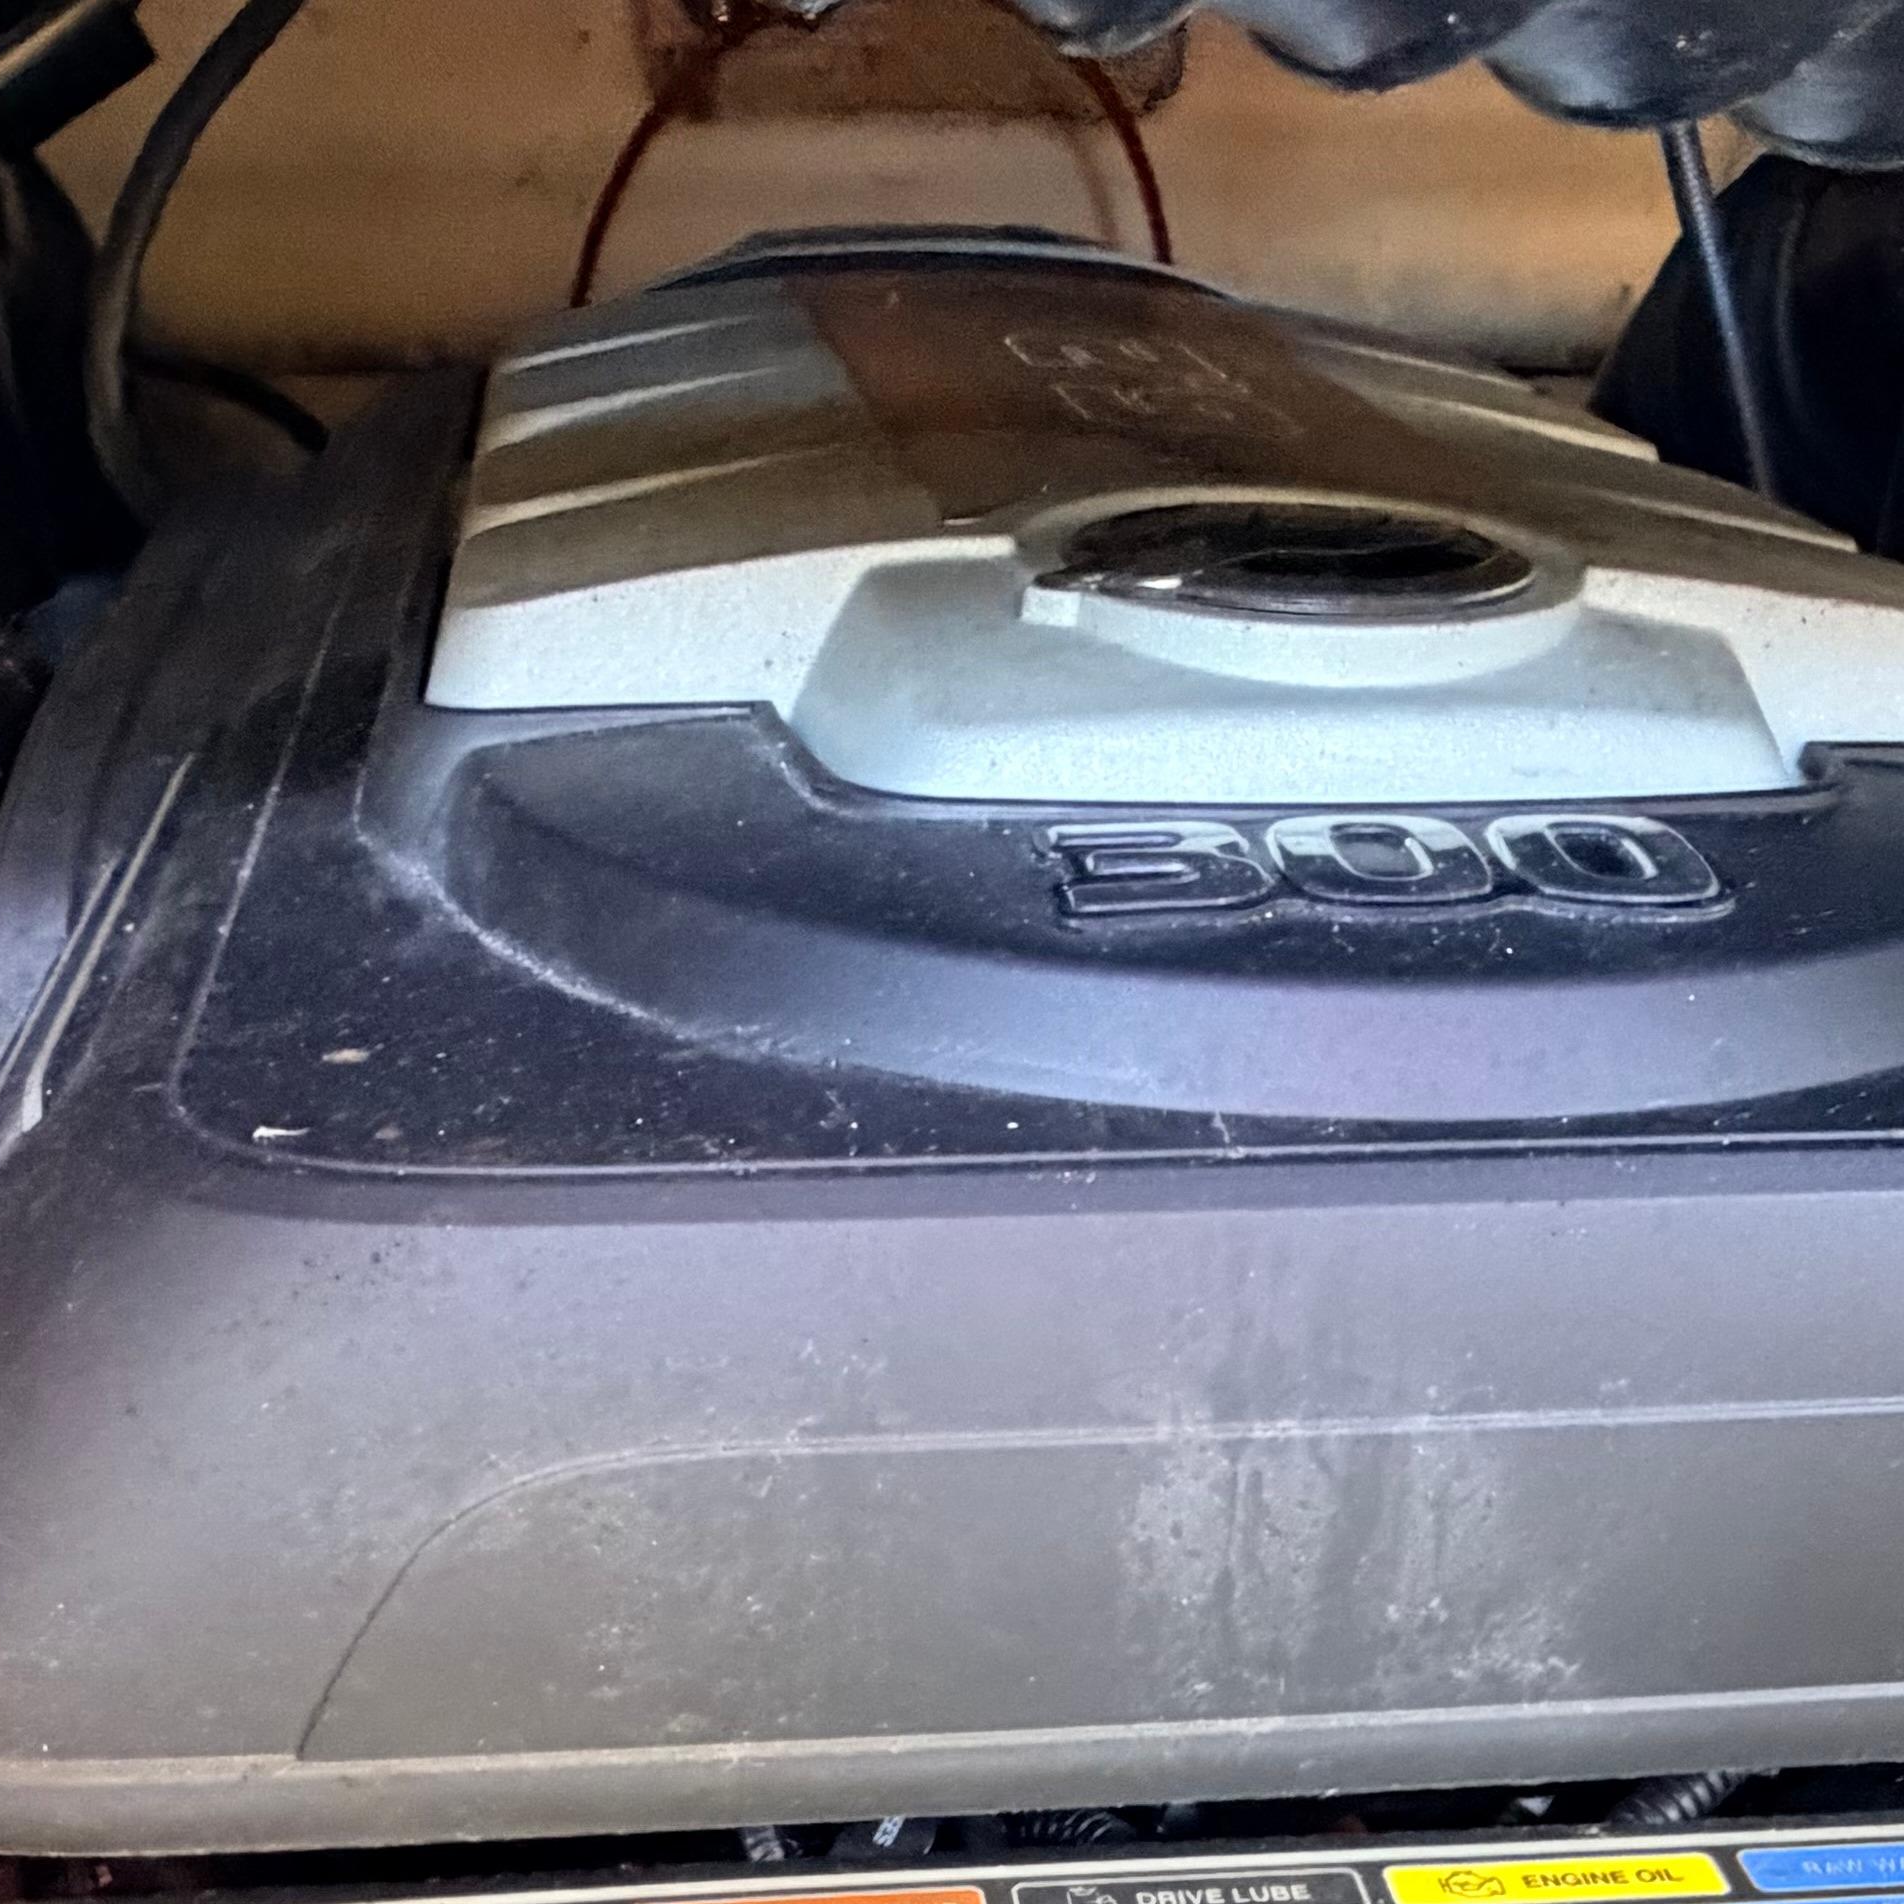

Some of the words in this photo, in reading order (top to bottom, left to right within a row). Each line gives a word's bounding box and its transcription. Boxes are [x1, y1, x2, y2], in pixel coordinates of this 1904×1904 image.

[1039, 814, 1724, 912] 300
[1521, 1870, 1629, 1888] ENGINE
[1635, 1868, 1683, 1882] OIL
[1231, 1883, 1310, 1903] LUBE
